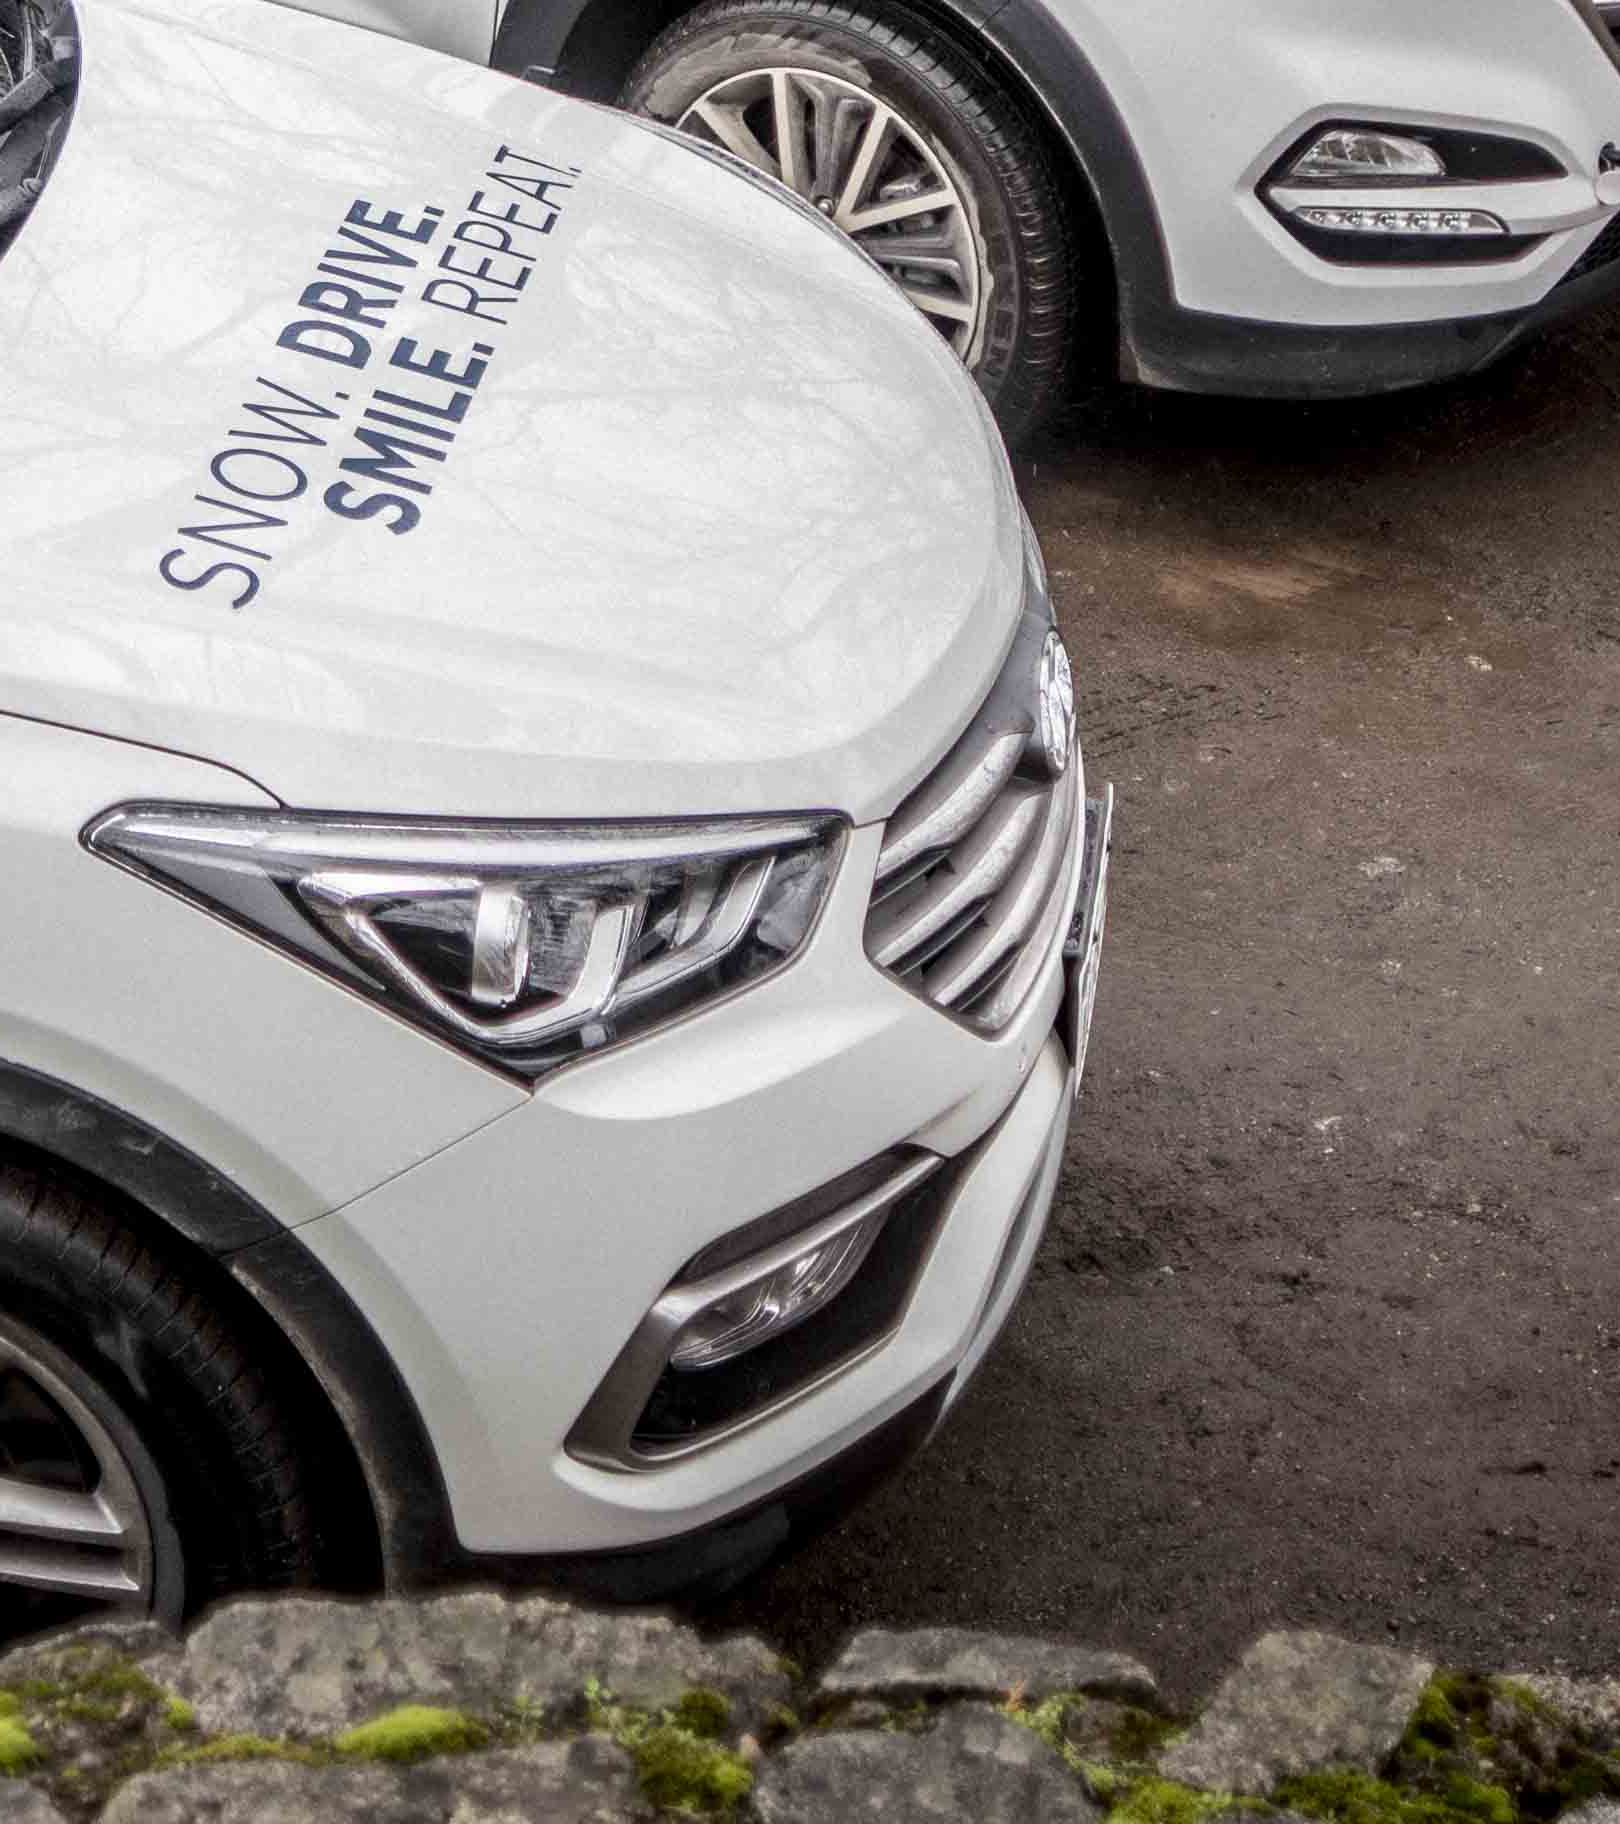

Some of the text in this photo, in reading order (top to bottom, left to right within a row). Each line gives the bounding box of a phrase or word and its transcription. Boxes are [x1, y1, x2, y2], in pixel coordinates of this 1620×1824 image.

[160, 200, 444, 609] SNOW. DRIVE.
[324, 145, 581, 534] SMILE. REPEAT.
